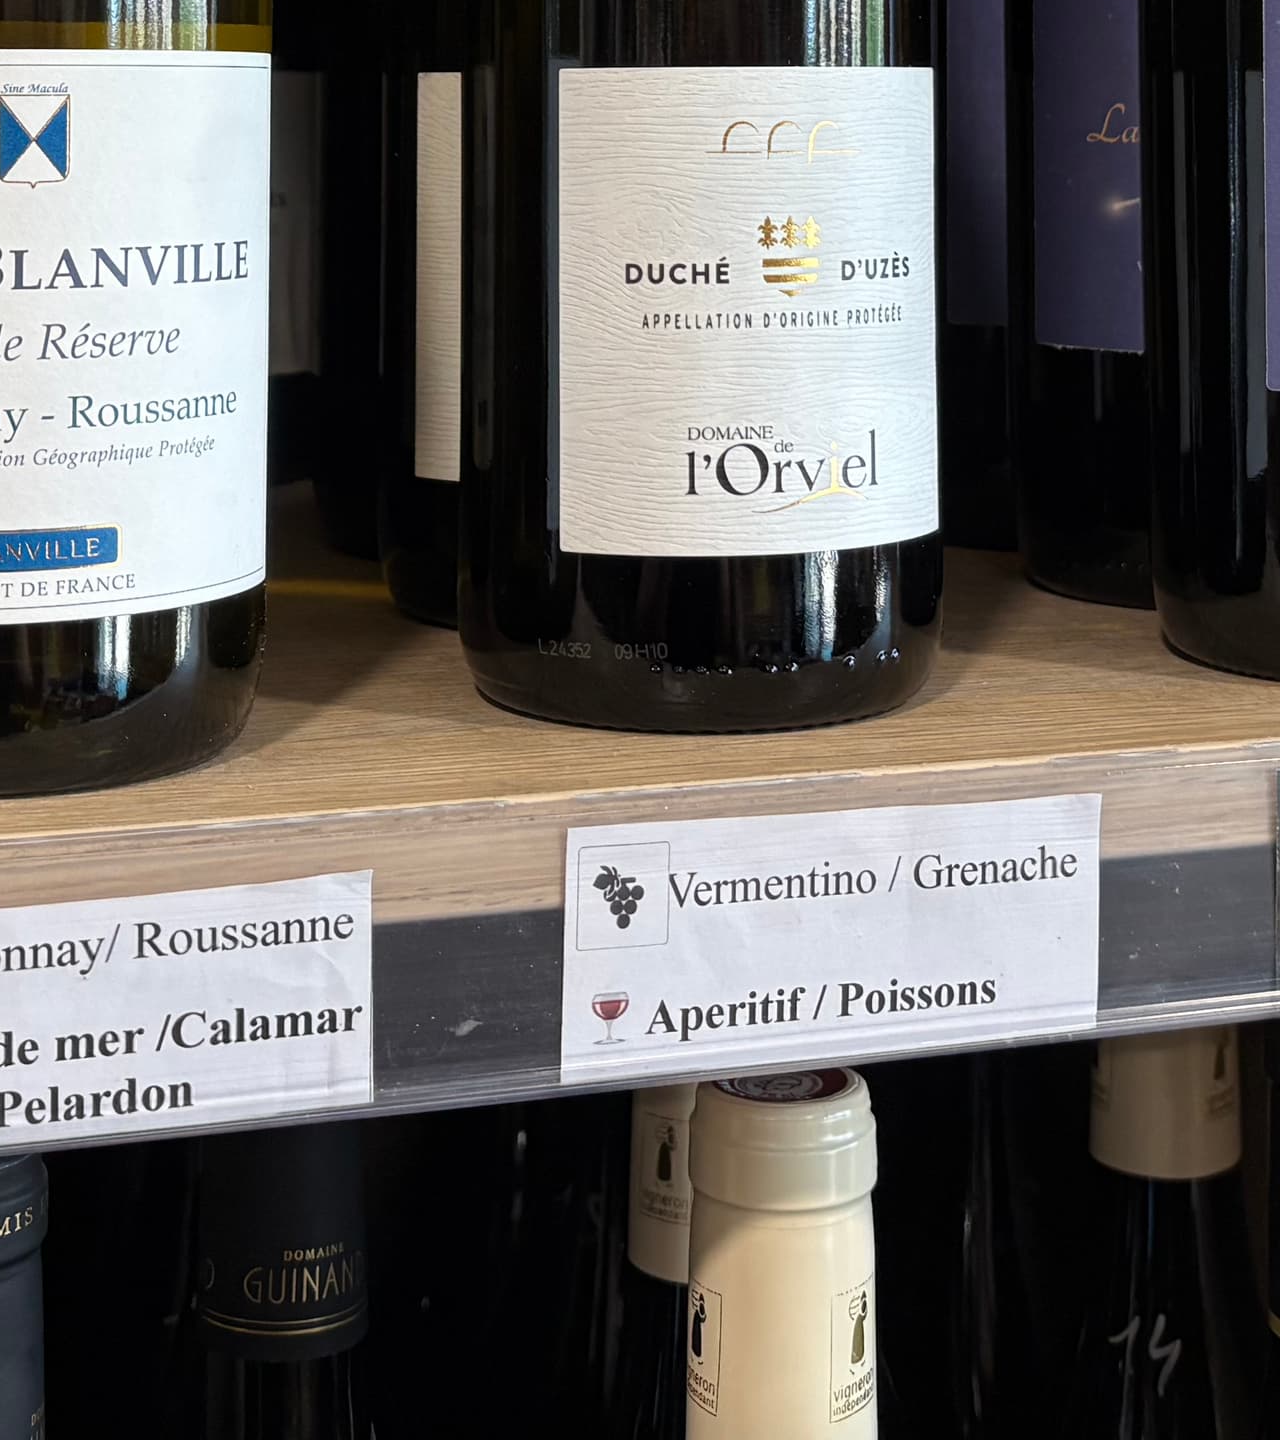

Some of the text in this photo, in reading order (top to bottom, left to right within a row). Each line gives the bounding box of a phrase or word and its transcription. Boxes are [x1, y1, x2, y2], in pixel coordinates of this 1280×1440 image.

[0, 82, 69, 94] Sine Macula
[624, 253, 910, 285] DUCHÉ D'UZÈS
[642, 305, 903, 330] APPELLATION D'ORIGINE PROTÉGÉE
[40, 321, 181, 362] Réserve
[67, 390, 237, 429] Roussanne
[687, 425, 774, 441] DOMAINE
[774, 439, 794, 454] de
[32, 442, 153, 470] Géographique
[158, 435, 216, 459] Protégée
[20, 579, 49, 598] DE
[55, 573, 136, 594] FRANCE
[668, 862, 878, 909] Vermentino
[913, 844, 1079, 890] Grenache
[133, 911, 355, 962] Roussanne
[645, 985, 806, 1040] Aperitif
[838, 975, 997, 1019] Poissons
[55, 1025, 144, 1062] mer
[156, 1000, 364, 1053] /Calamar
[283, 1242, 344, 1261] DOMAINE
